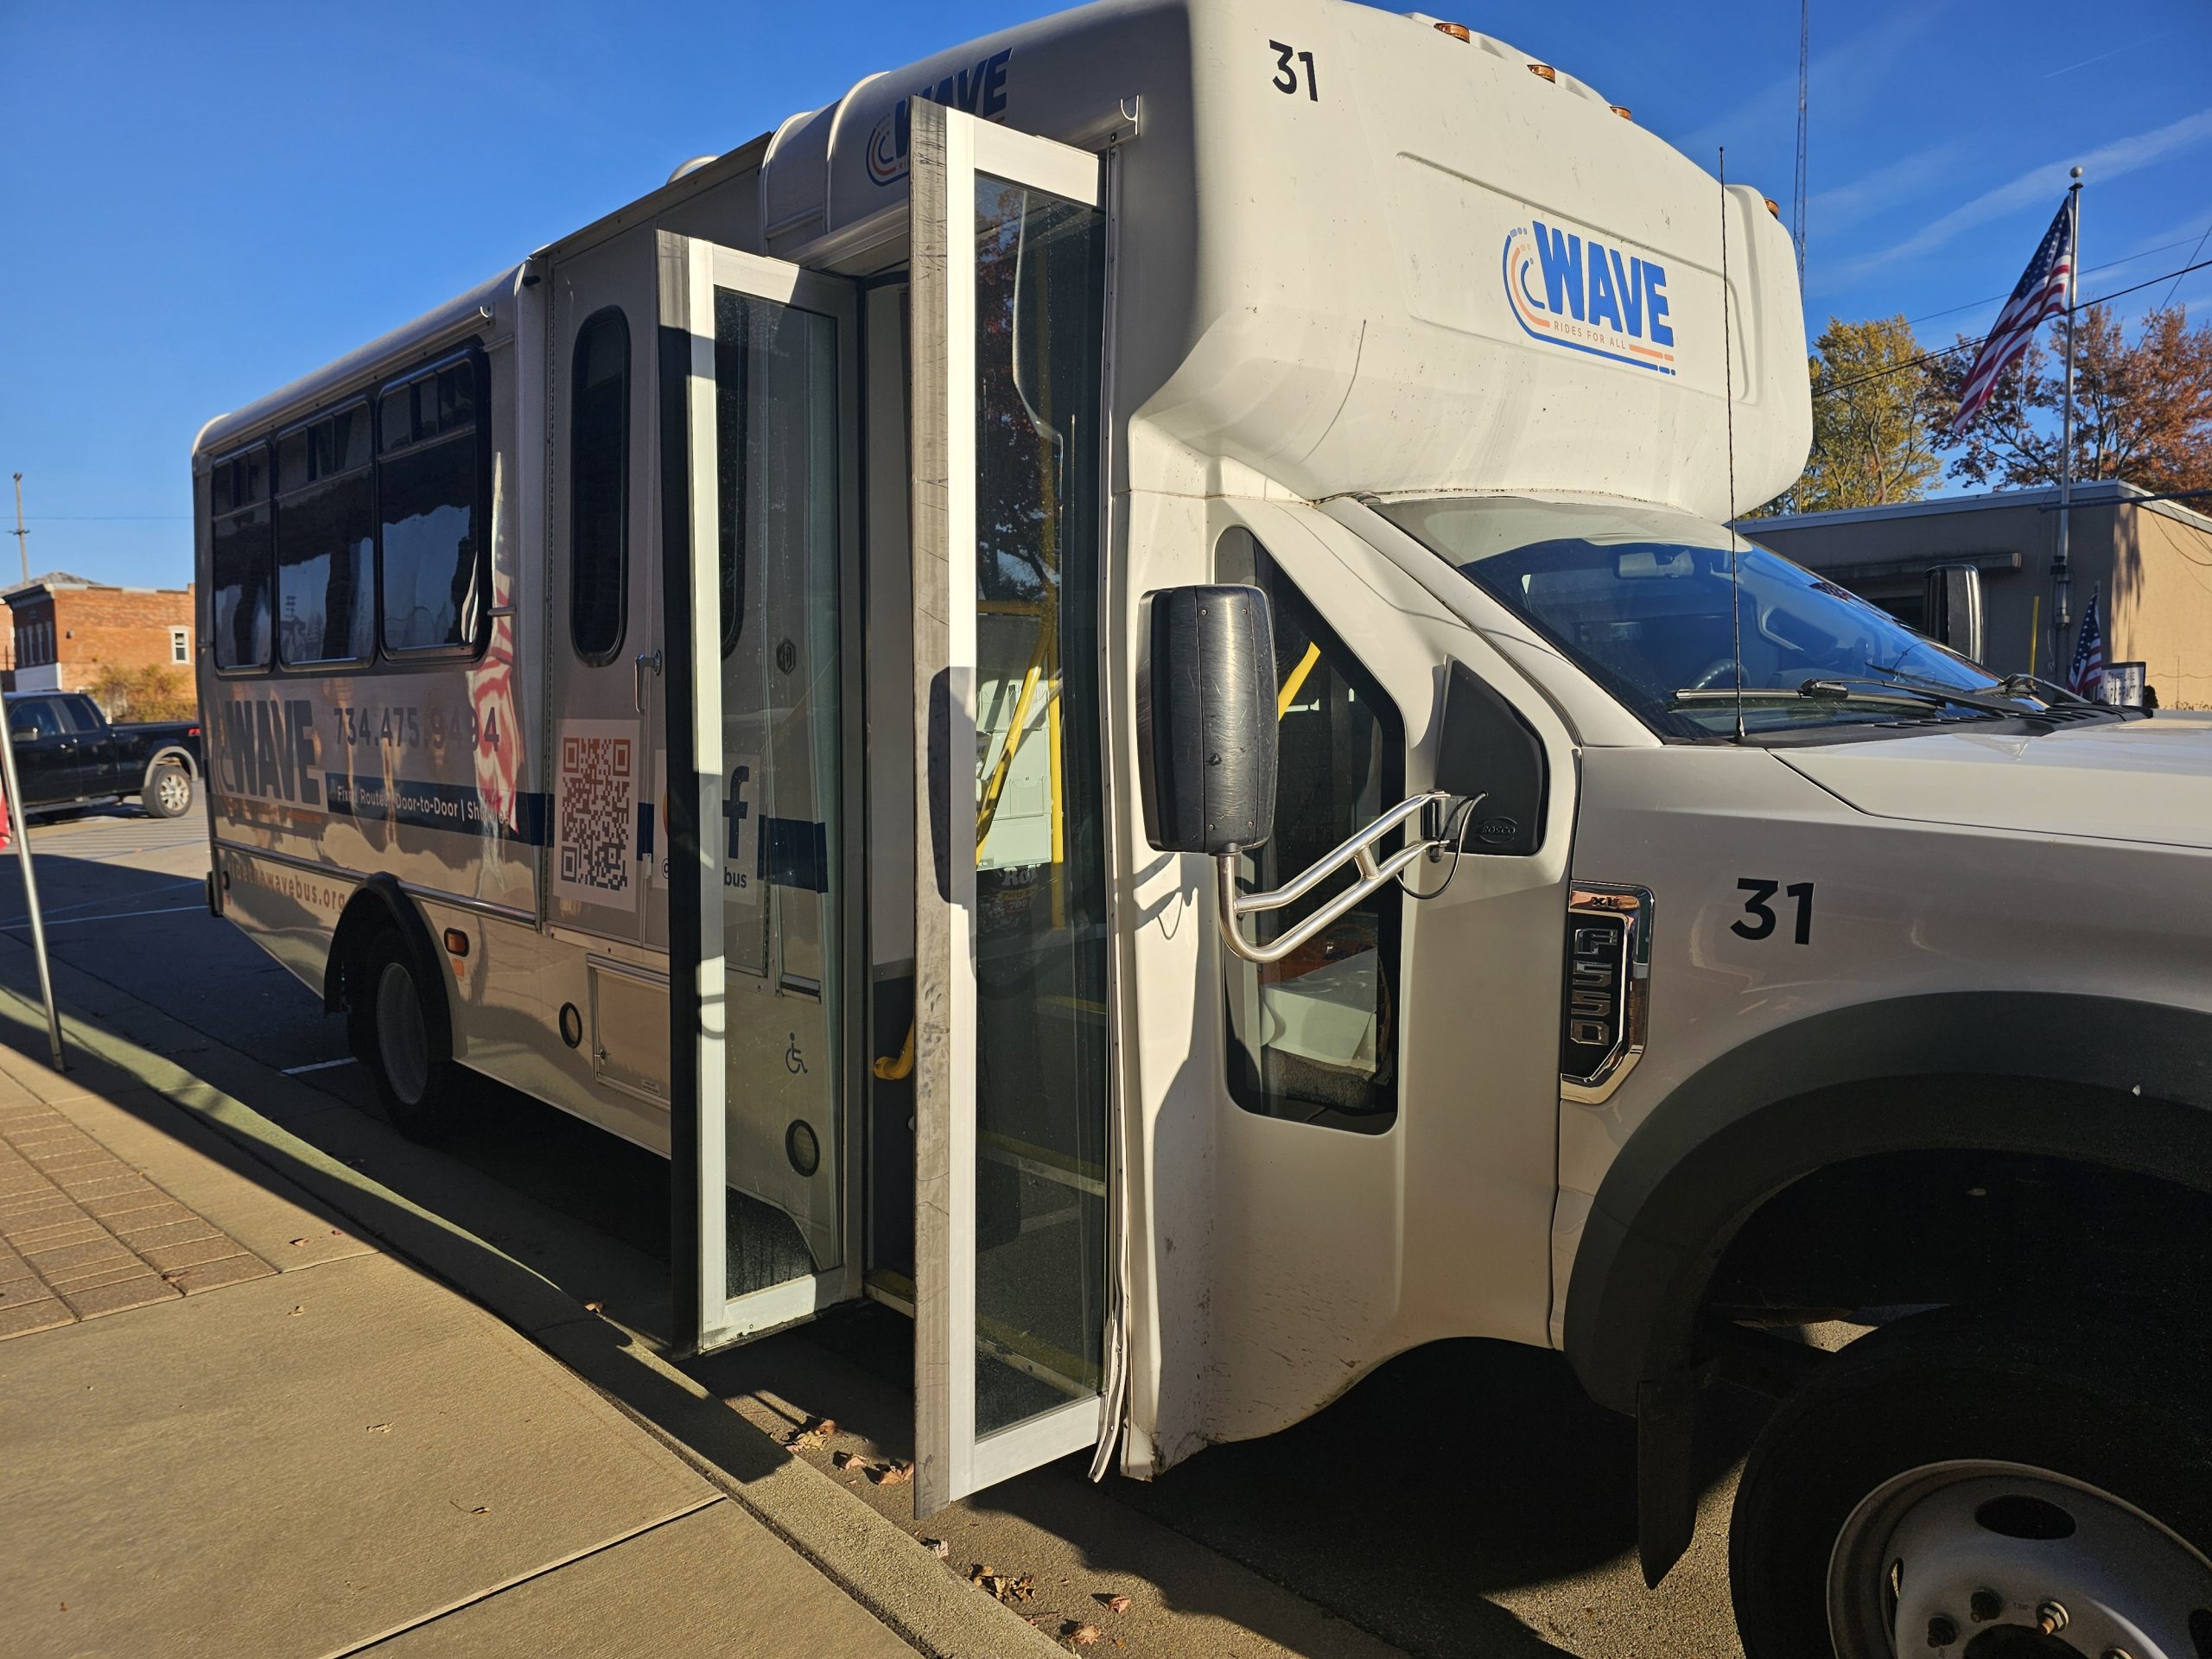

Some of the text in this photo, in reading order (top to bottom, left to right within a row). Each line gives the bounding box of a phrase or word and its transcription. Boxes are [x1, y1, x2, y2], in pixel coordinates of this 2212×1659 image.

[1268, 39, 1319, 102] 31
[1532, 220, 1675, 347] WAVE
[1554, 321, 1626, 350] RIDES FOR ALL
[225, 699, 321, 805] WAVE
[396, 794, 458, 817] Door-to-Door
[1482, 825, 1516, 835] ROSCO
[1590, 896, 1618, 908] XL
[1730, 877, 1815, 945] 31
